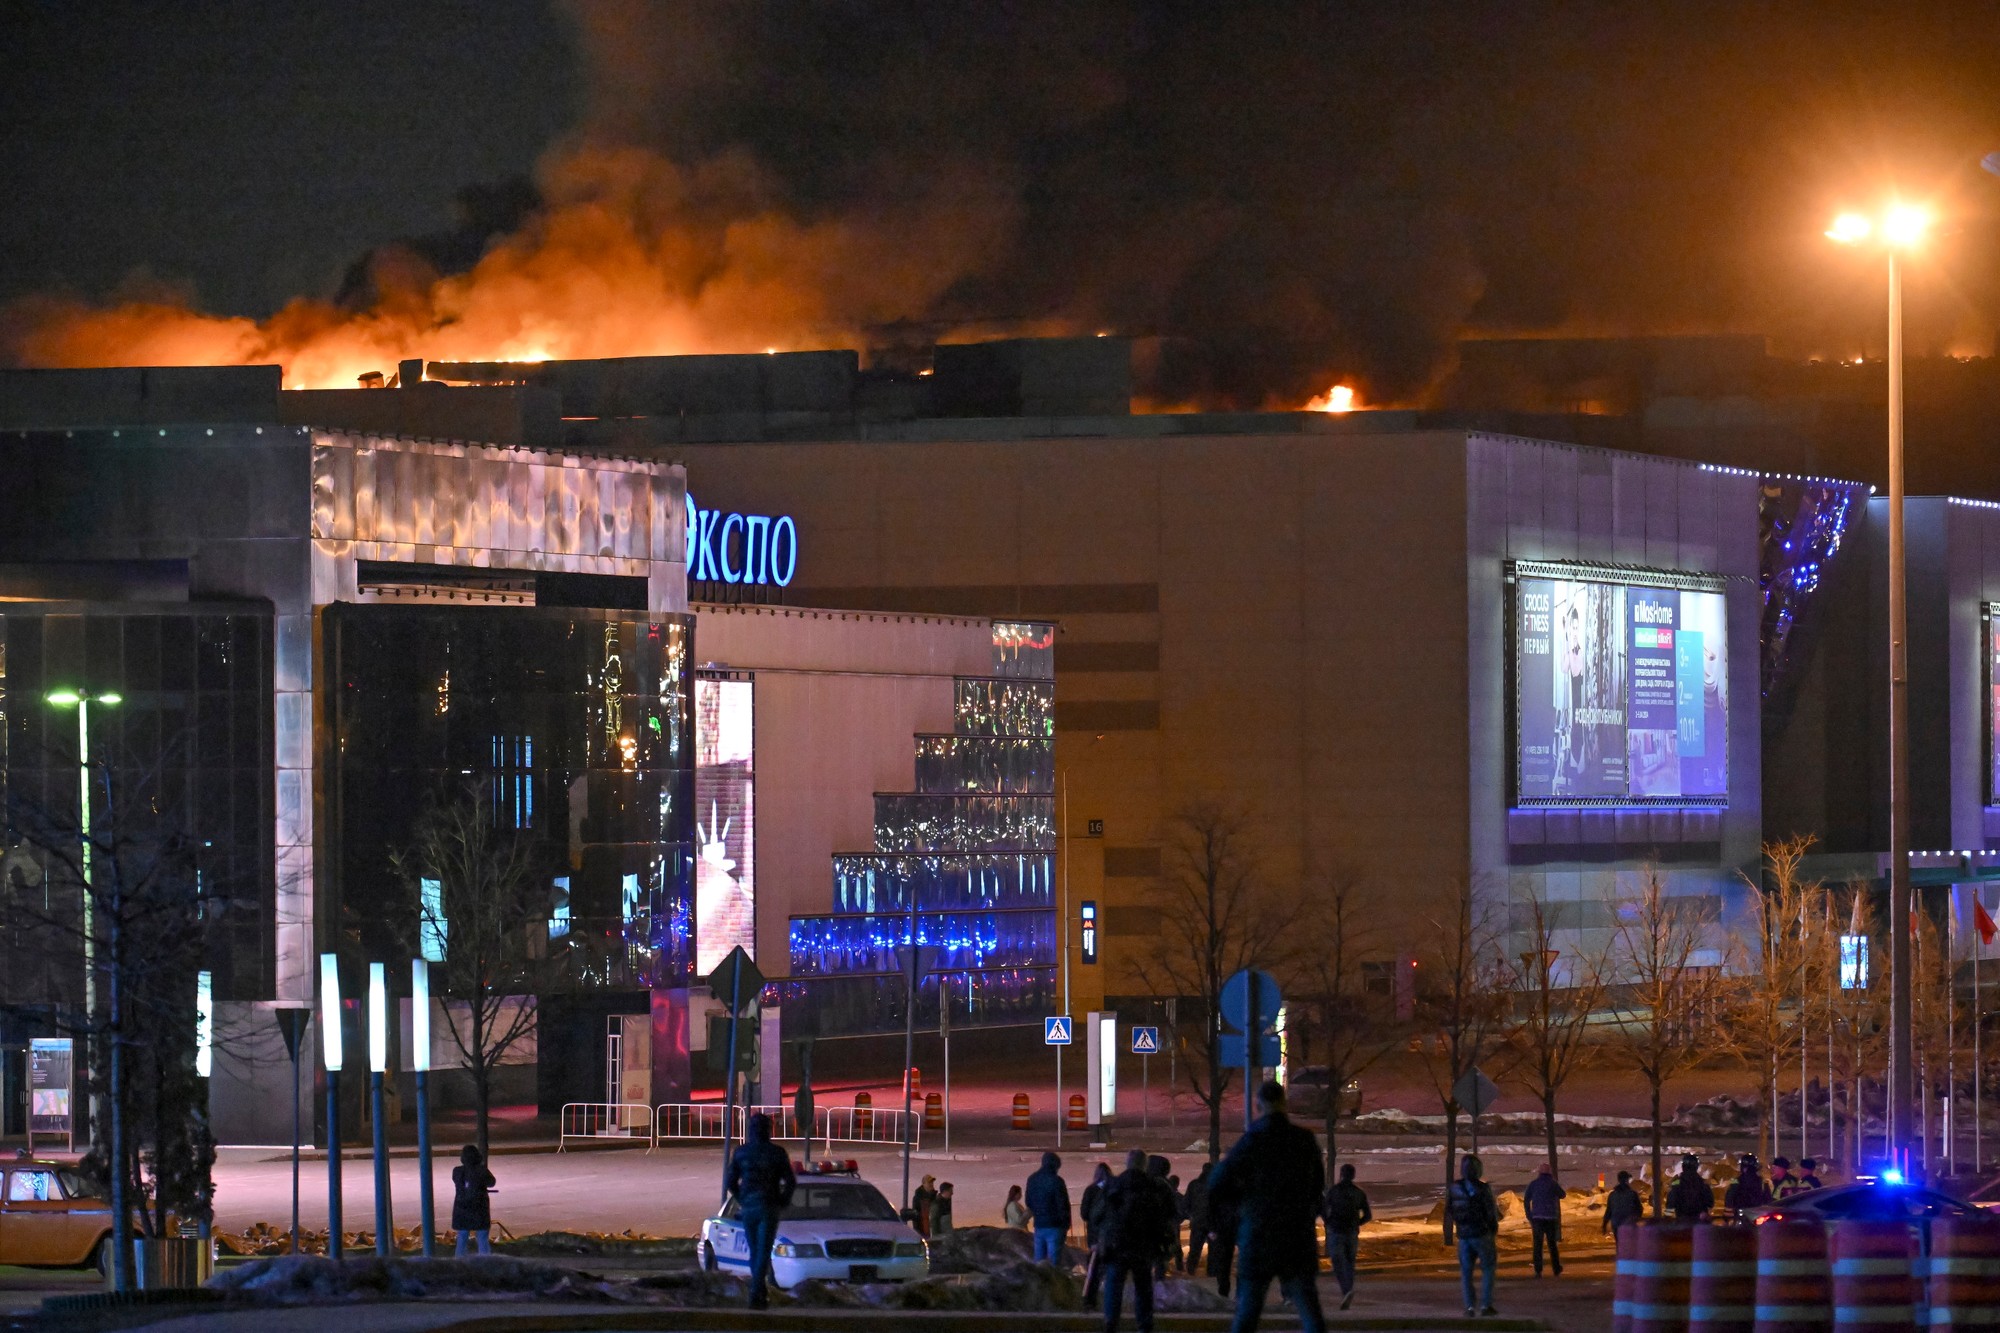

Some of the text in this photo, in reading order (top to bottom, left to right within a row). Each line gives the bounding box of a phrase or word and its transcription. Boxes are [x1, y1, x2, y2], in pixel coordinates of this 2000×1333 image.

[1524, 594, 1549, 612] CROCUS
[1524, 613, 1549, 633] FITNESS
[1524, 635, 1549, 655] ПЕРВЫЙ
[1089, 822, 1102, 832] 16
